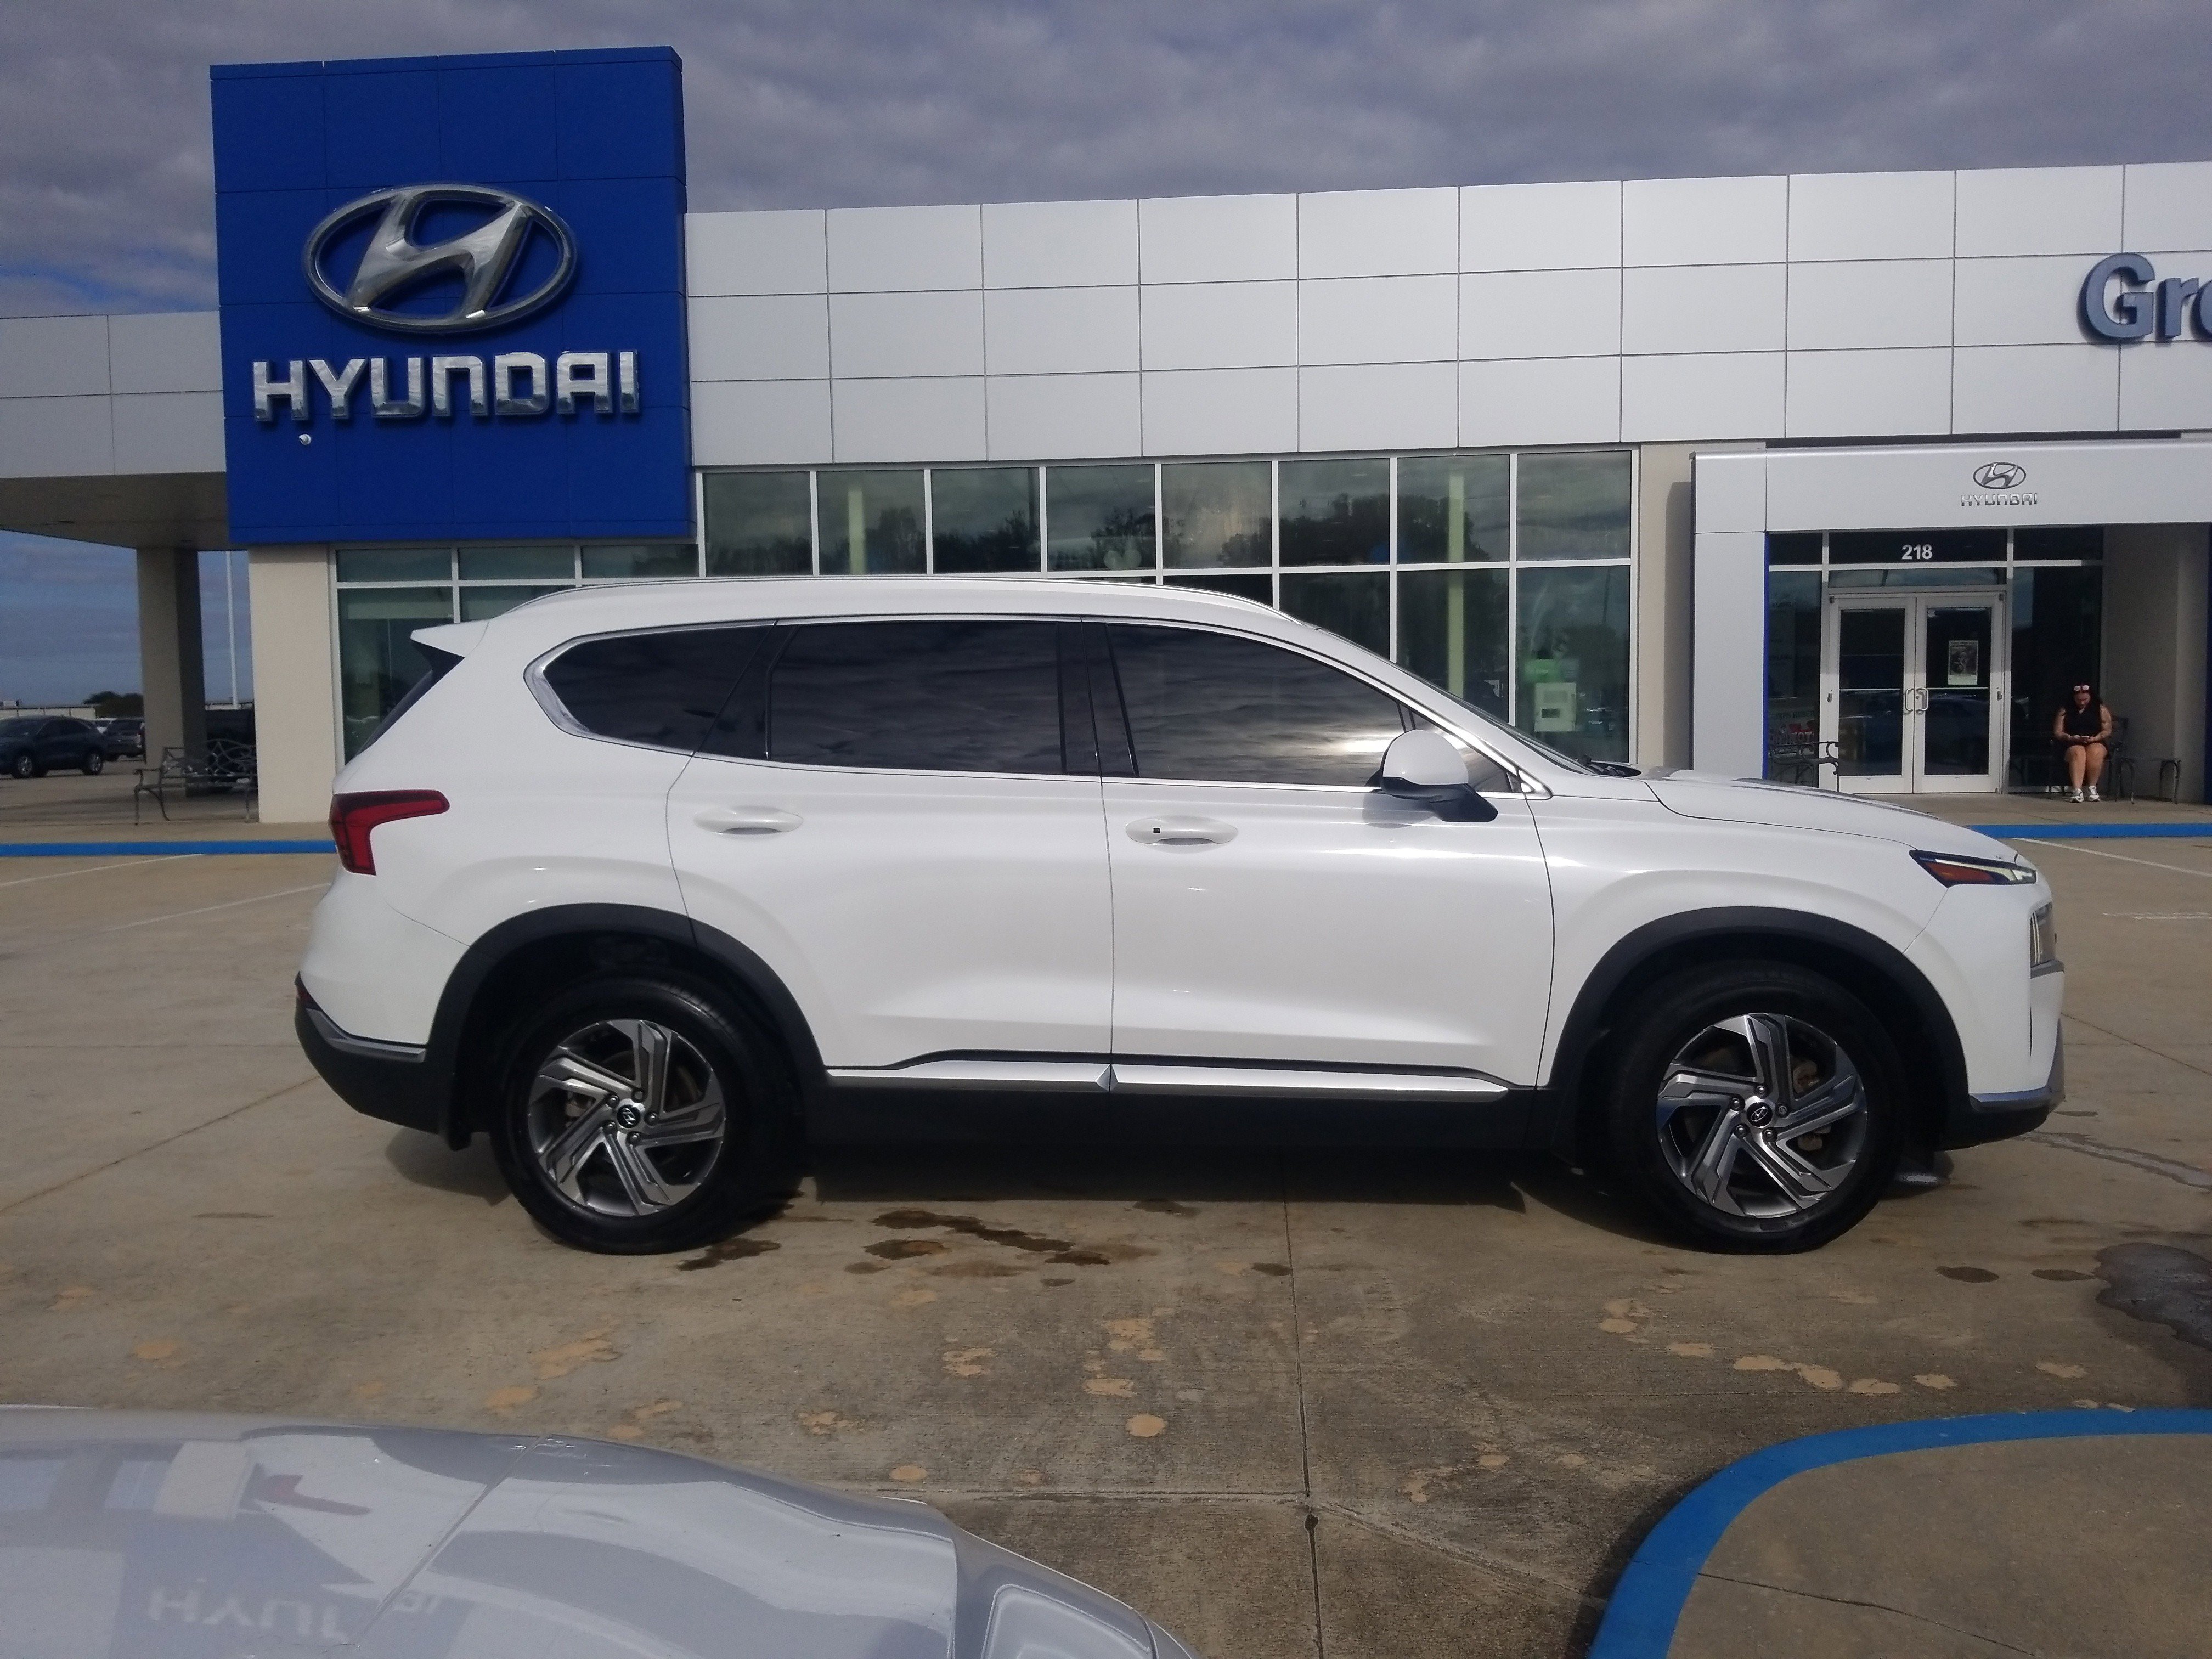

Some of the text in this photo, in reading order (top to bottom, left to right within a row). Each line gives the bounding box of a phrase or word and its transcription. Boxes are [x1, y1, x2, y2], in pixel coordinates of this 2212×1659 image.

[252, 350, 640, 422] HYUNDAI
[1961, 493, 2038, 507] HYUNDAI
[1901, 544, 1933, 560] 218
